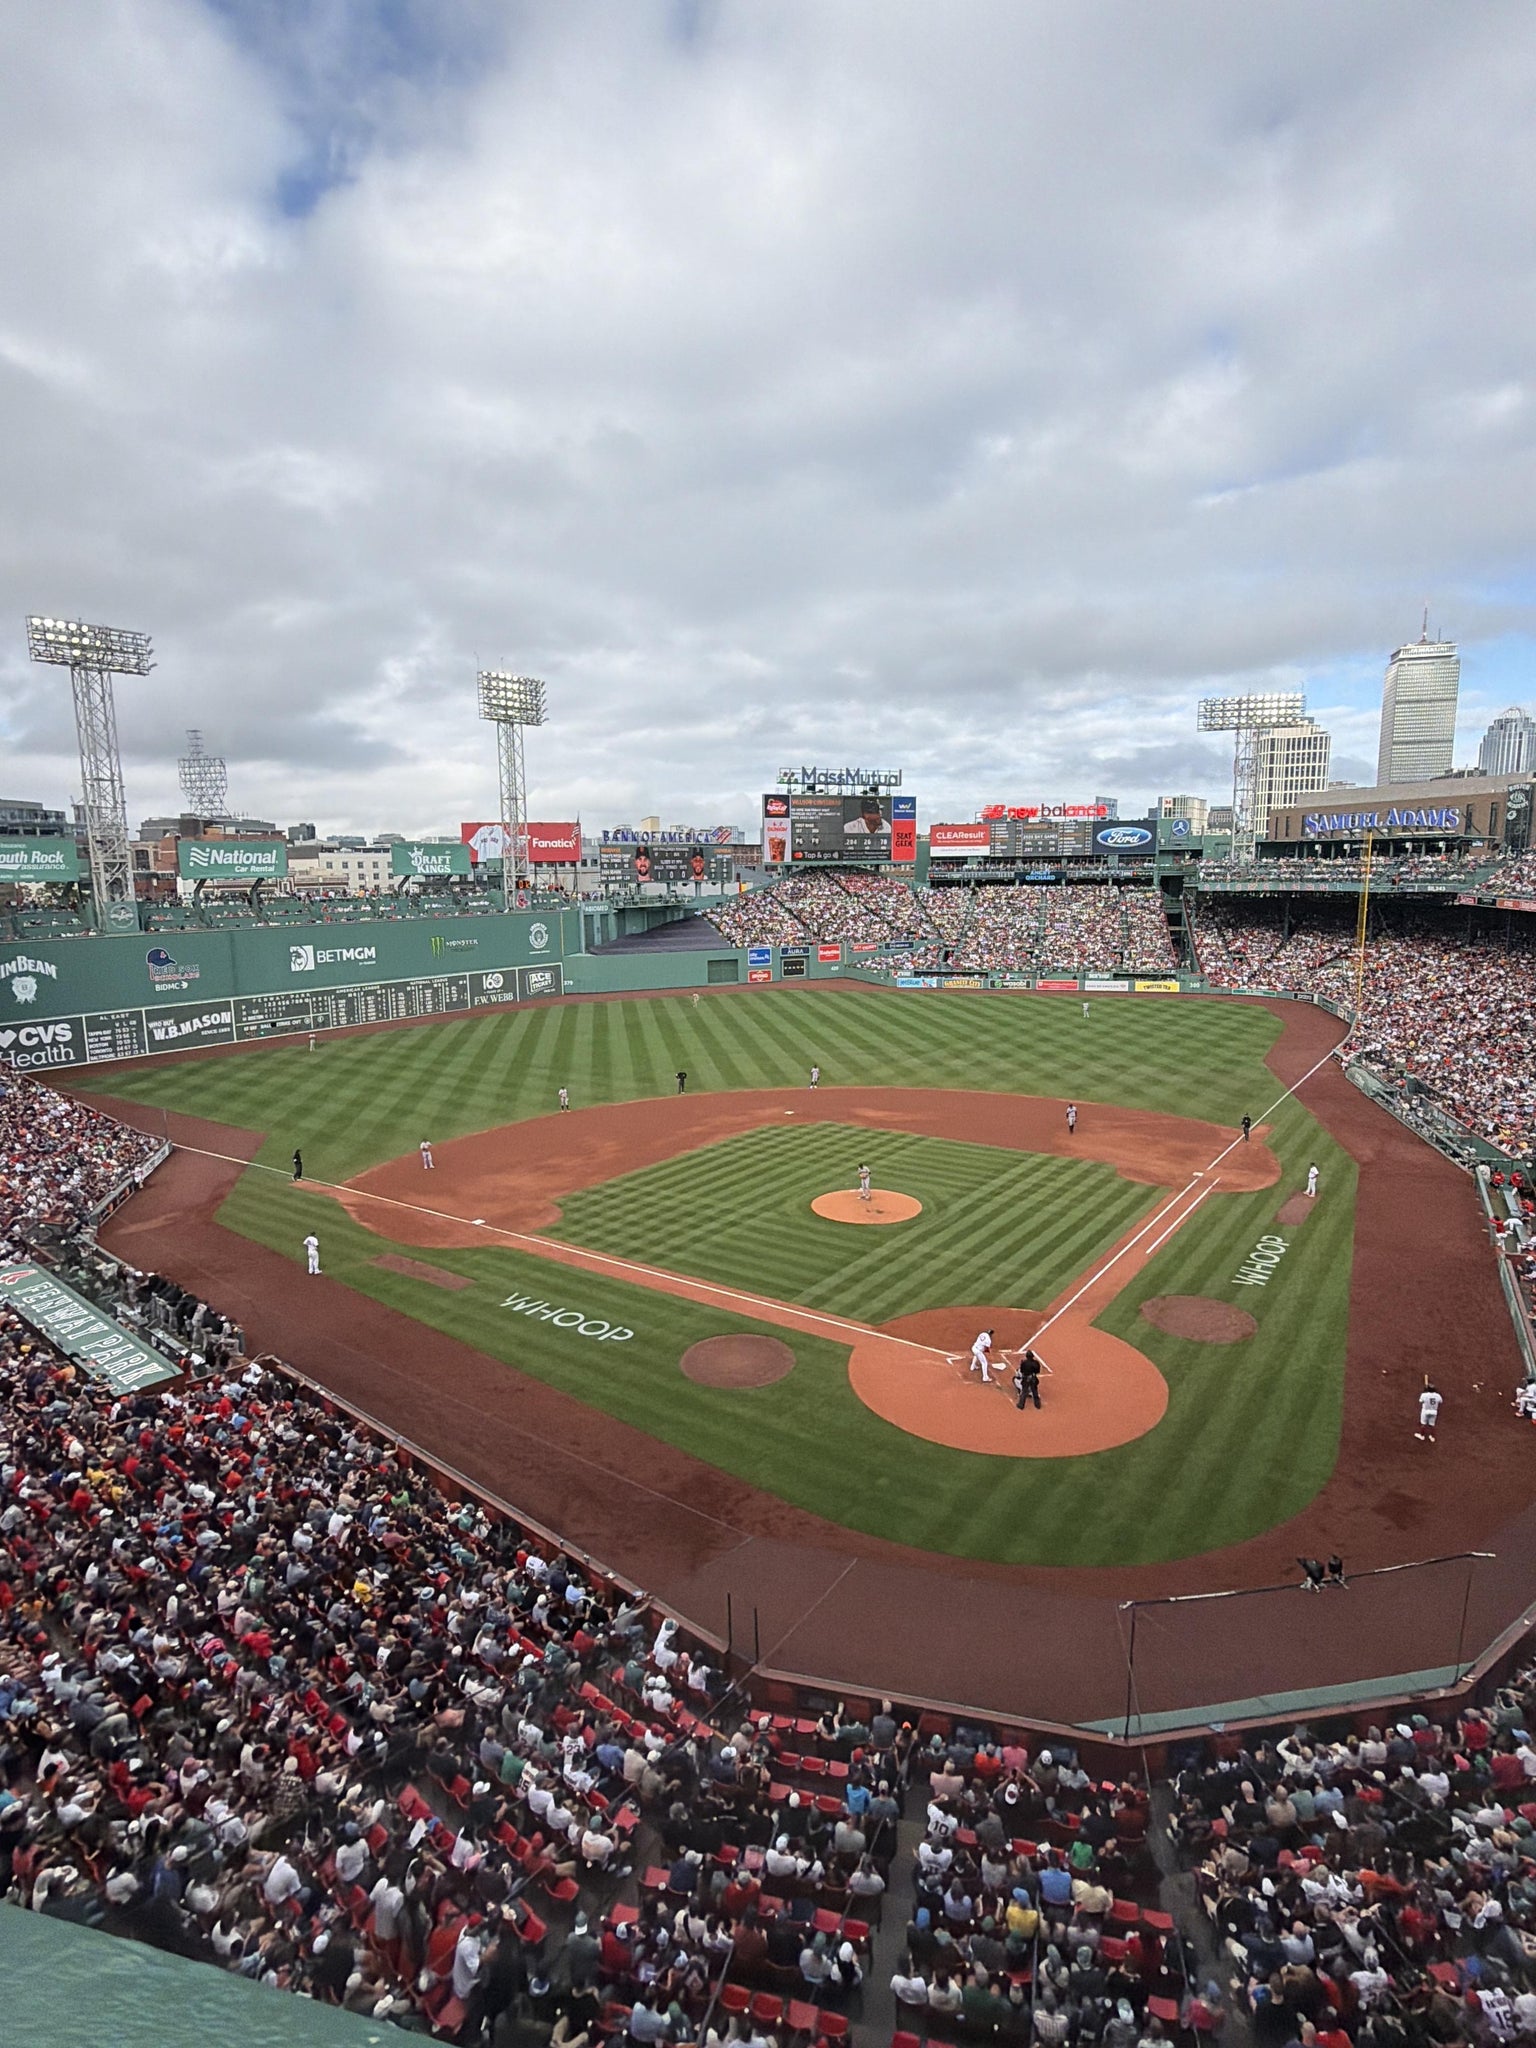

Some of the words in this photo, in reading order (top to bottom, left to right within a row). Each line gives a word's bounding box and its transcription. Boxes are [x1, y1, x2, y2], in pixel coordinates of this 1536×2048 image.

[802, 766, 902, 786] MassMutual
[1007, 806, 1039, 819] new
[1041, 802, 1107, 817] balance
[1304, 812, 1383, 834] SAMUEL
[1386, 807, 1460, 828] ADAMS
[602, 829, 639, 843] BANK
[640, 830, 657, 843] OF
[659, 830, 712, 844] AMERICA
[896, 831, 912, 840] SEAT
[1107, 829, 1141, 844] Ford
[31, 851, 65, 864] Rock
[411, 855, 452, 867] DRAFT
[235, 865, 249, 873] Car
[250, 865, 275, 873] Rental
[417, 864, 452, 874] KINGS
[446, 938, 479, 948] MONSTER
[316, 946, 376, 963] BETMGM
[16, 955, 58, 980] BEAM
[531, 972, 552, 983] ACE
[532, 980, 553, 990] TICKET
[155, 982, 180, 991] BIDMC
[490, 992, 514, 1002] WEBB
[147, 1020, 161, 1029] WHO
[162, 1018, 174, 1027] BUY
[153, 1011, 232, 1041] W.B.MASON
[19, 1023, 73, 1047] CVS
[1231, 1234, 1290, 1286] WHOOP
[499, 1292, 634, 1341] WHOOP
[14, 1280, 109, 1341] FENWAY
[80, 1333, 164, 1386] PARK
[934, 1820, 949, 1836] 10
